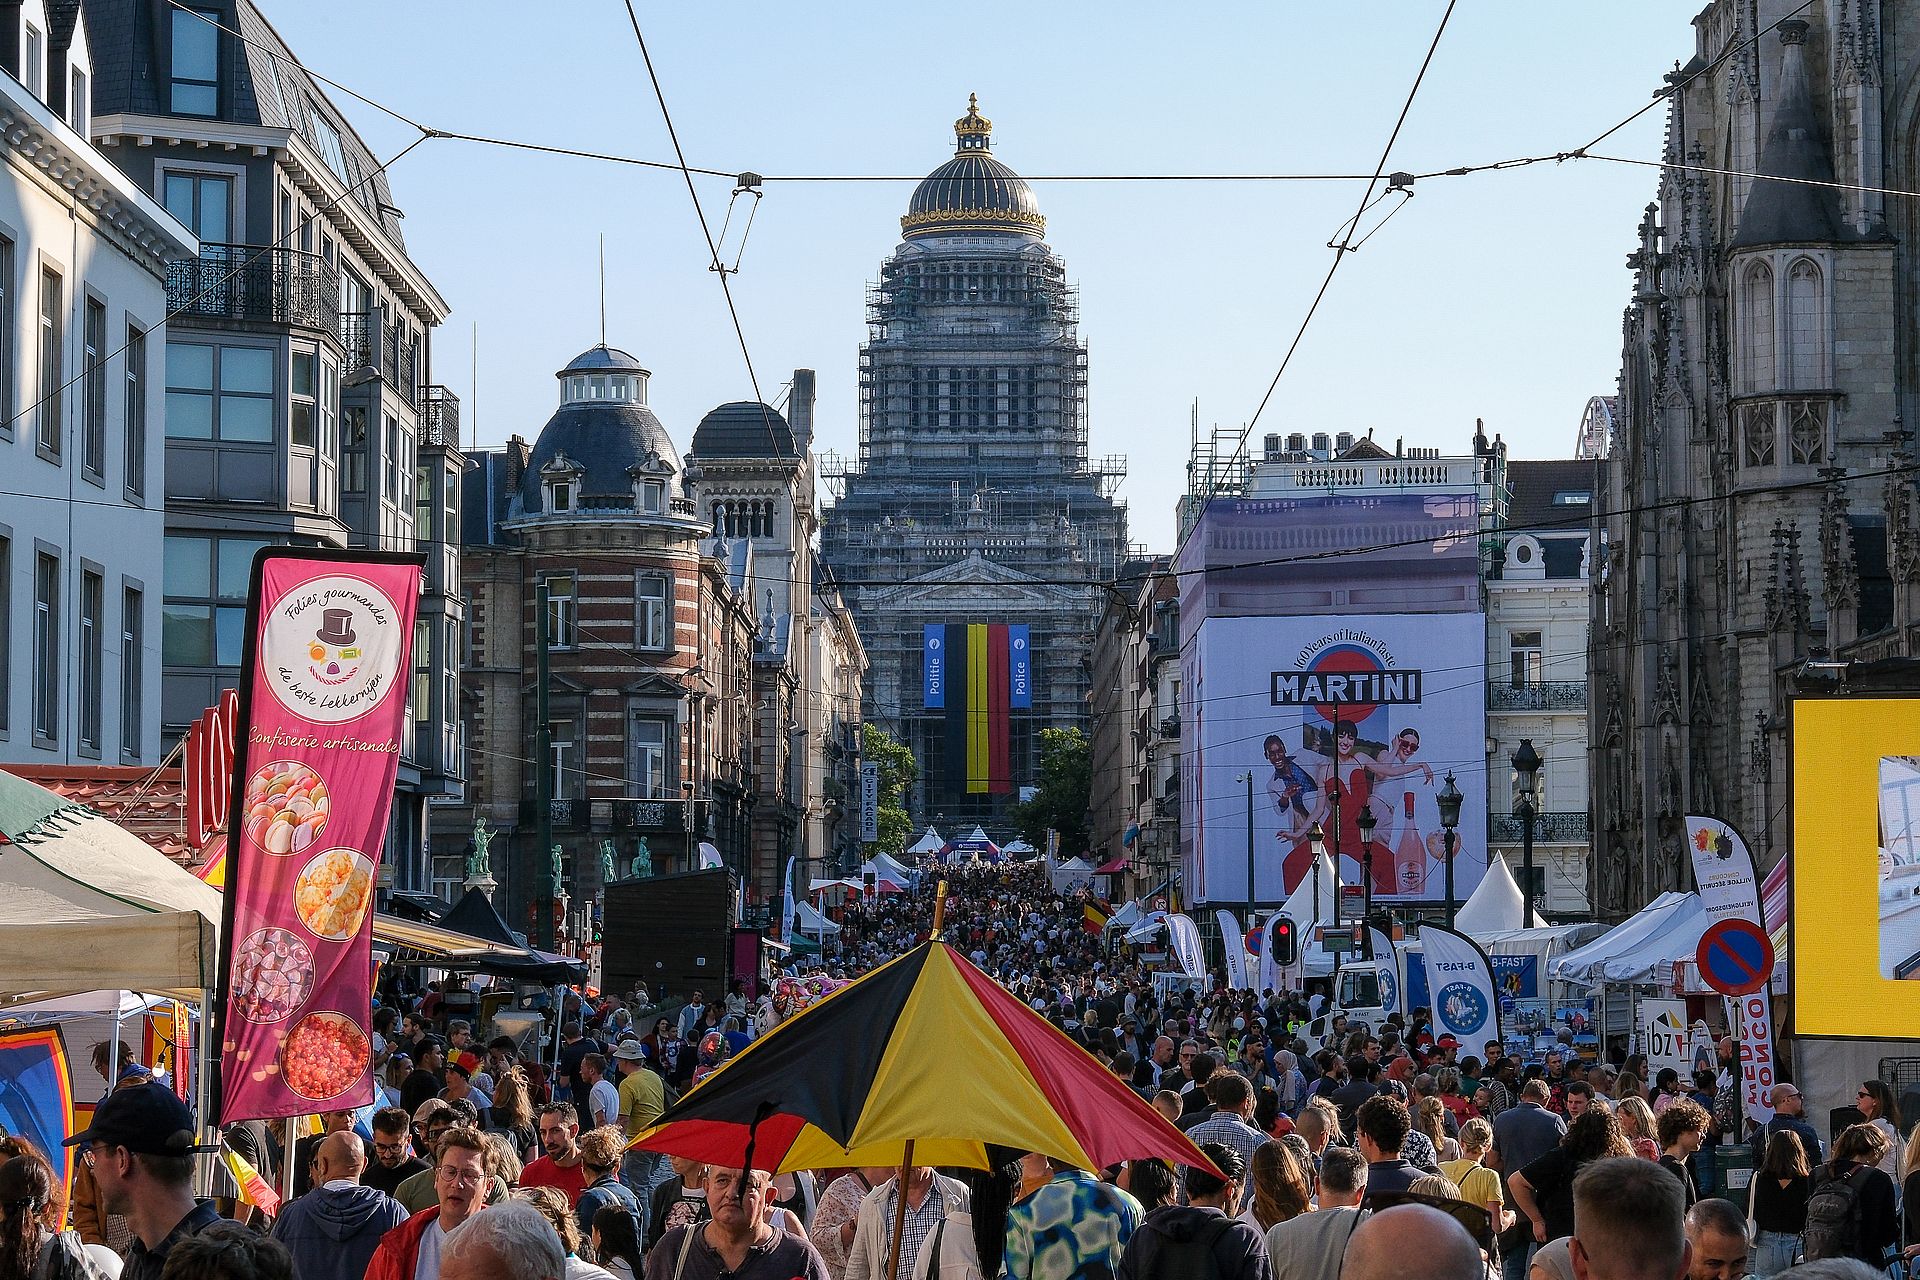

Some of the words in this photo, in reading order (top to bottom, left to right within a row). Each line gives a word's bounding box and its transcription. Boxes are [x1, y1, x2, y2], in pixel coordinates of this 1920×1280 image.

[284, 593, 318, 620] Folies
[318, 589, 388, 626] gourmandes
[1293, 650, 1310, 669] 160
[1306, 634, 1333, 654] Years
[1333, 628, 1344, 641] of
[1345, 628, 1379, 649] Italian
[1375, 639, 1397, 668] Taste
[278, 665, 292, 683] de
[289, 682, 317, 706] beste
[319, 673, 383, 709] Lekkernijen
[929, 657, 940, 695] Politie
[1015, 661, 1026, 696] Police
[1276, 673, 1416, 702] MARTINI
[248, 725, 319, 752] Confiserie
[323, 734, 399, 754] artisanale
[865, 778, 874, 799] CITY
[1491, 957, 1526, 968] B-FAST
[1646, 1020, 1673, 1057] ibz
